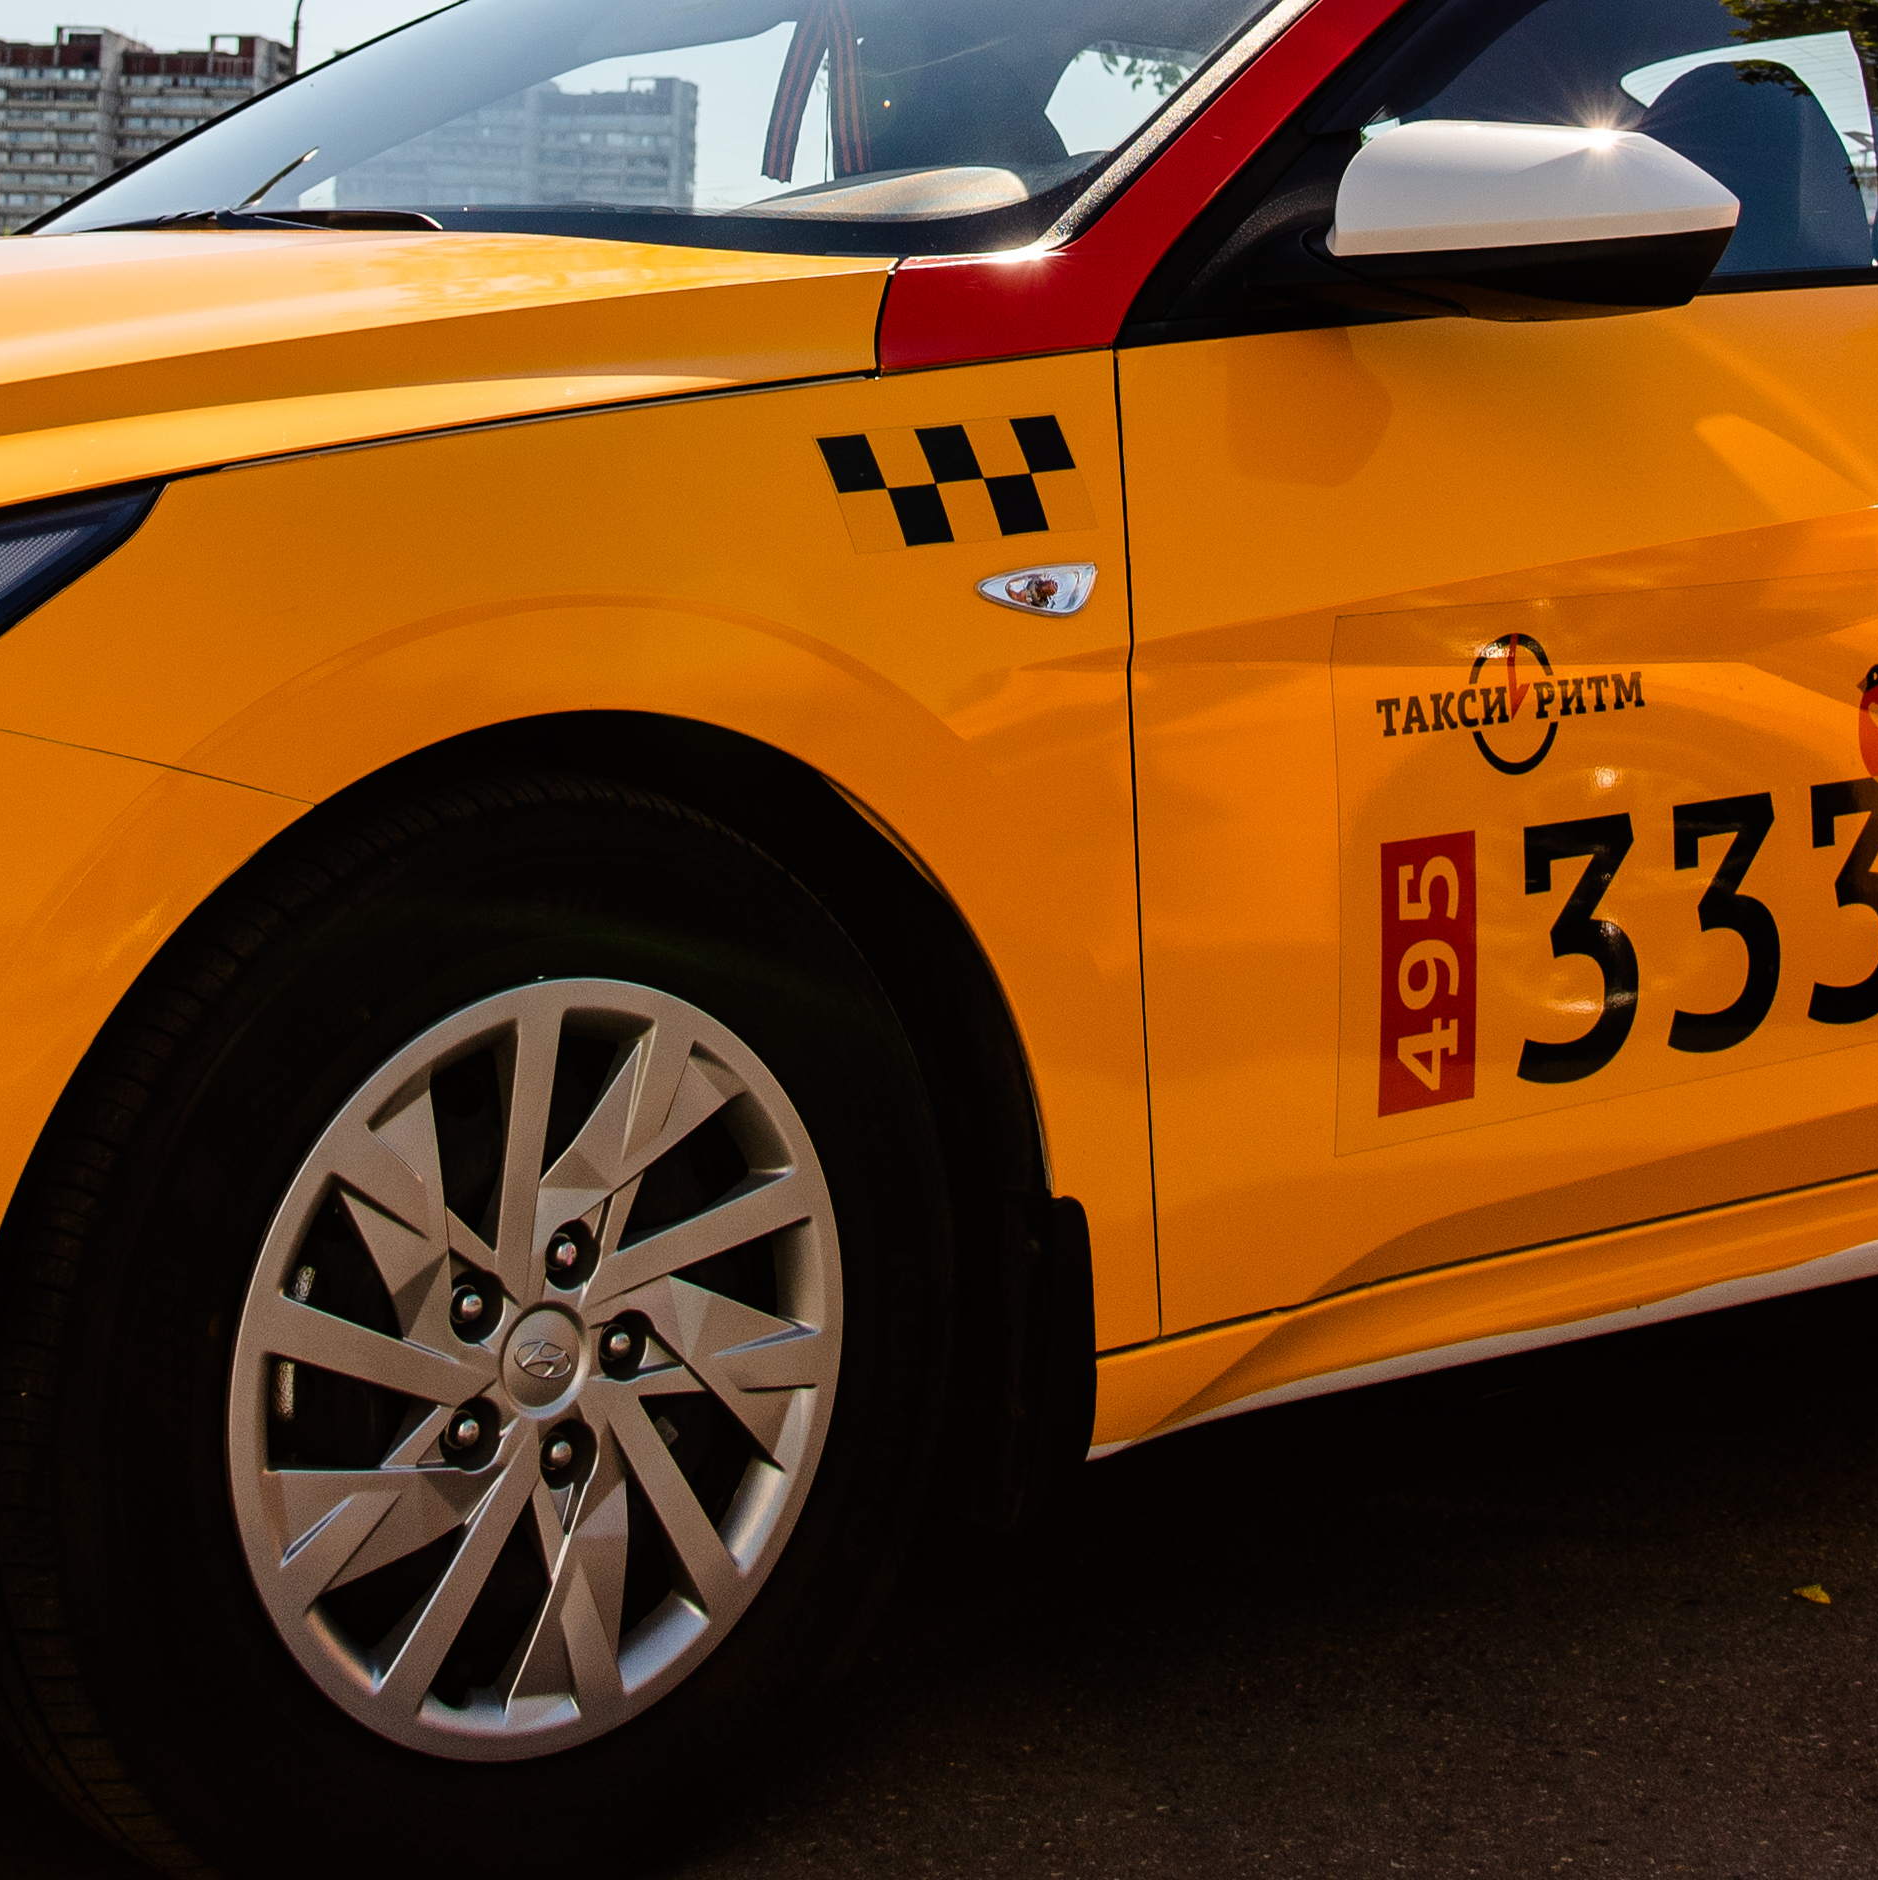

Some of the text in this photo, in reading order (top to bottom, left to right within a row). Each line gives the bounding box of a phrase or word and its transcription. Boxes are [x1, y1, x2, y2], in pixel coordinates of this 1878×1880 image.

[1375, 671, 1646, 738] ТАКСИ РИТМ
[1397, 854, 1460, 1091] 495
